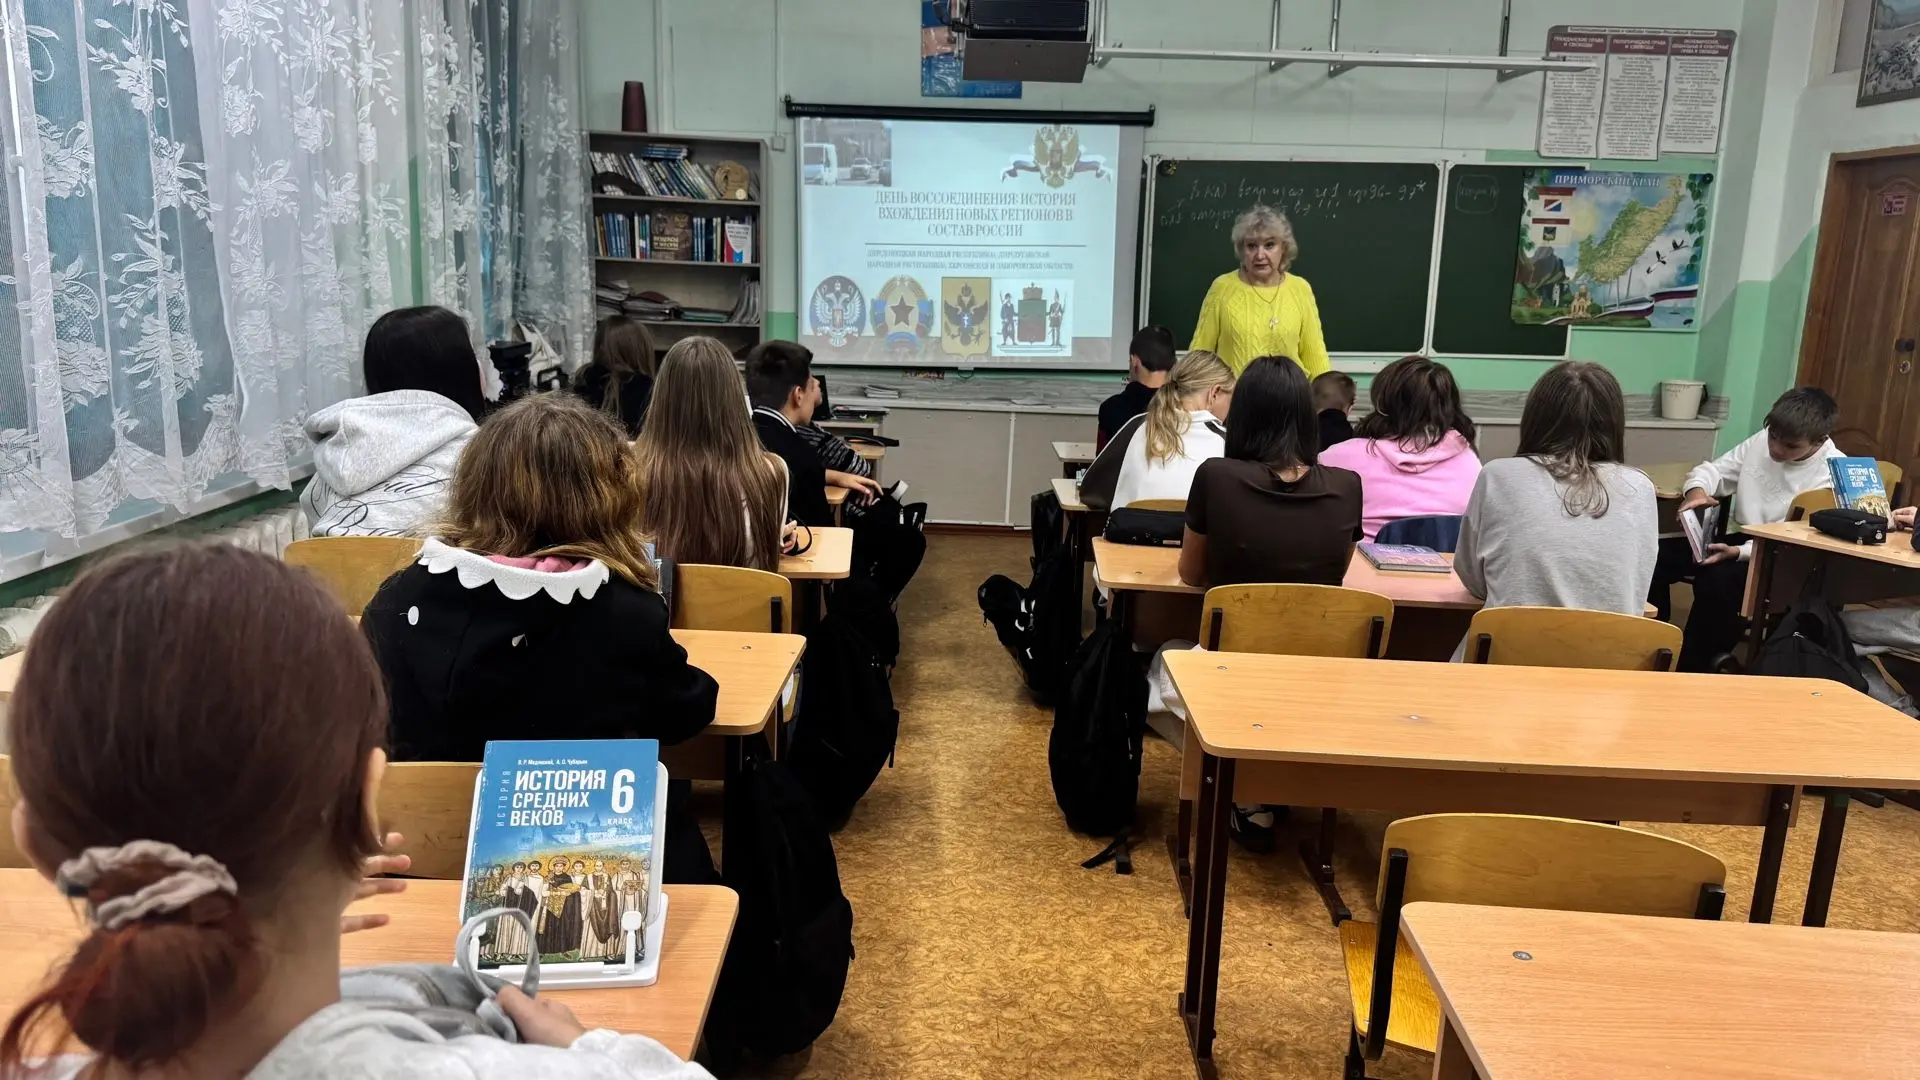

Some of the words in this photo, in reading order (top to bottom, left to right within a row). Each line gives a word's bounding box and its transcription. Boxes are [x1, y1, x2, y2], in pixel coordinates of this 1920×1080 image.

[1554, 175, 1630, 186] ПРИМОРСКИЙ
[875, 191, 907, 204] ДЕНЬ
[1020, 192, 1076, 206] ИСТОРИЯ
[879, 206, 954, 221] ВХОЖДЕНИЯ
[956, 208, 998, 221] НОВЫХ
[1001, 208, 1064, 221] РЕГИОНОВ
[1065, 208, 1073, 221] В
[927, 223, 974, 237] СОСТАВ
[975, 224, 1023, 237] РОССИИ
[1869, 467, 1877, 483] 6
[514, 769, 607, 791] ИСТОРИЯ
[496, 770, 511, 827] ИСТОРИЯ
[611, 768, 636, 814] 6
[512, 791, 590, 810] СРЕДНИХ
[509, 810, 564, 826] ВЕКОВ
